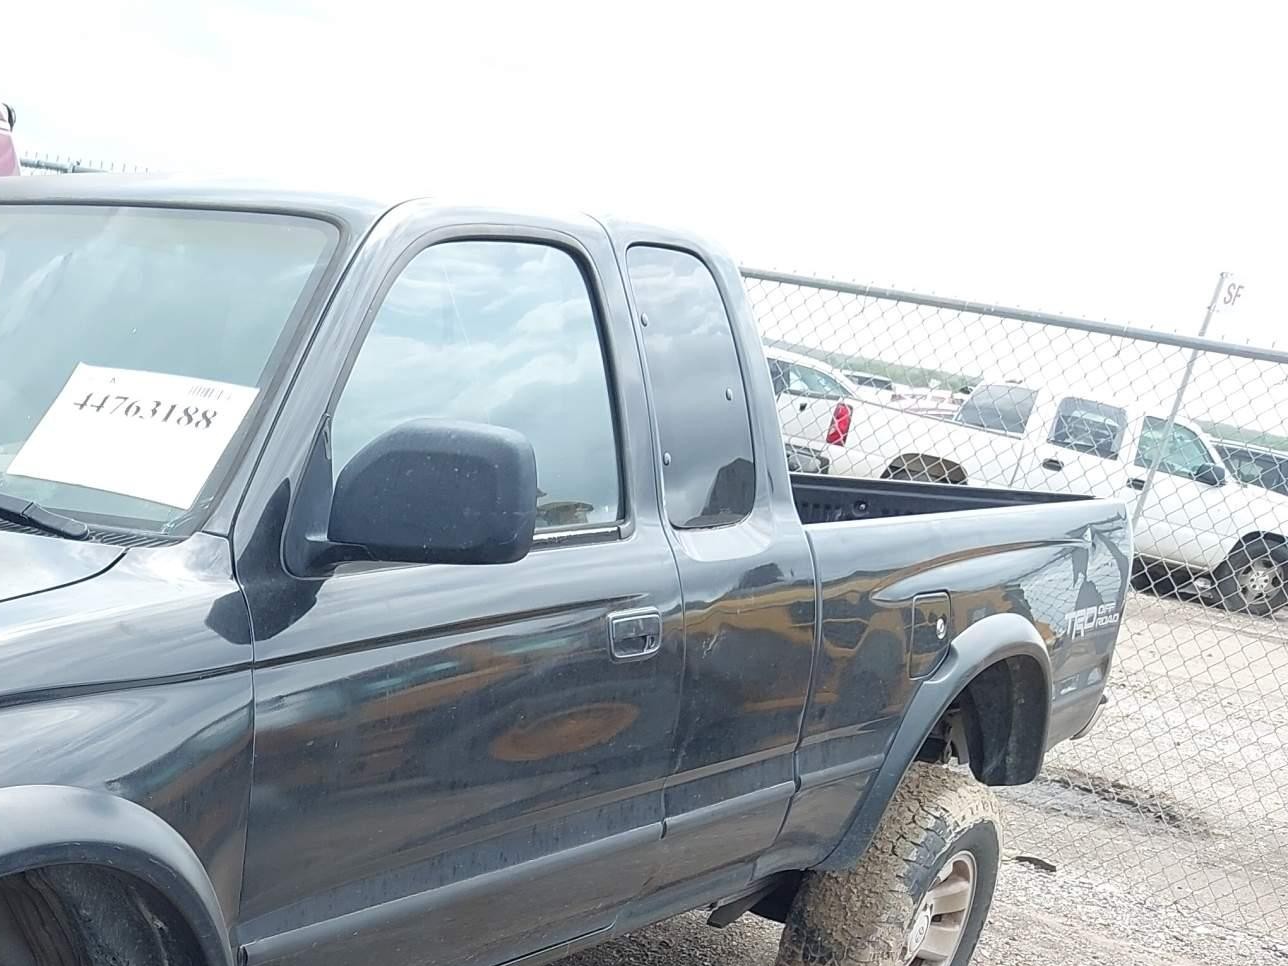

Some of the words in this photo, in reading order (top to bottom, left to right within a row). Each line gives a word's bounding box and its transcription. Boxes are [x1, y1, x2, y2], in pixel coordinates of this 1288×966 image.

[73, 392, 218, 429] 44763188
[1065, 606, 1098, 640] TRD
[1096, 613, 1120, 628] ROAD
